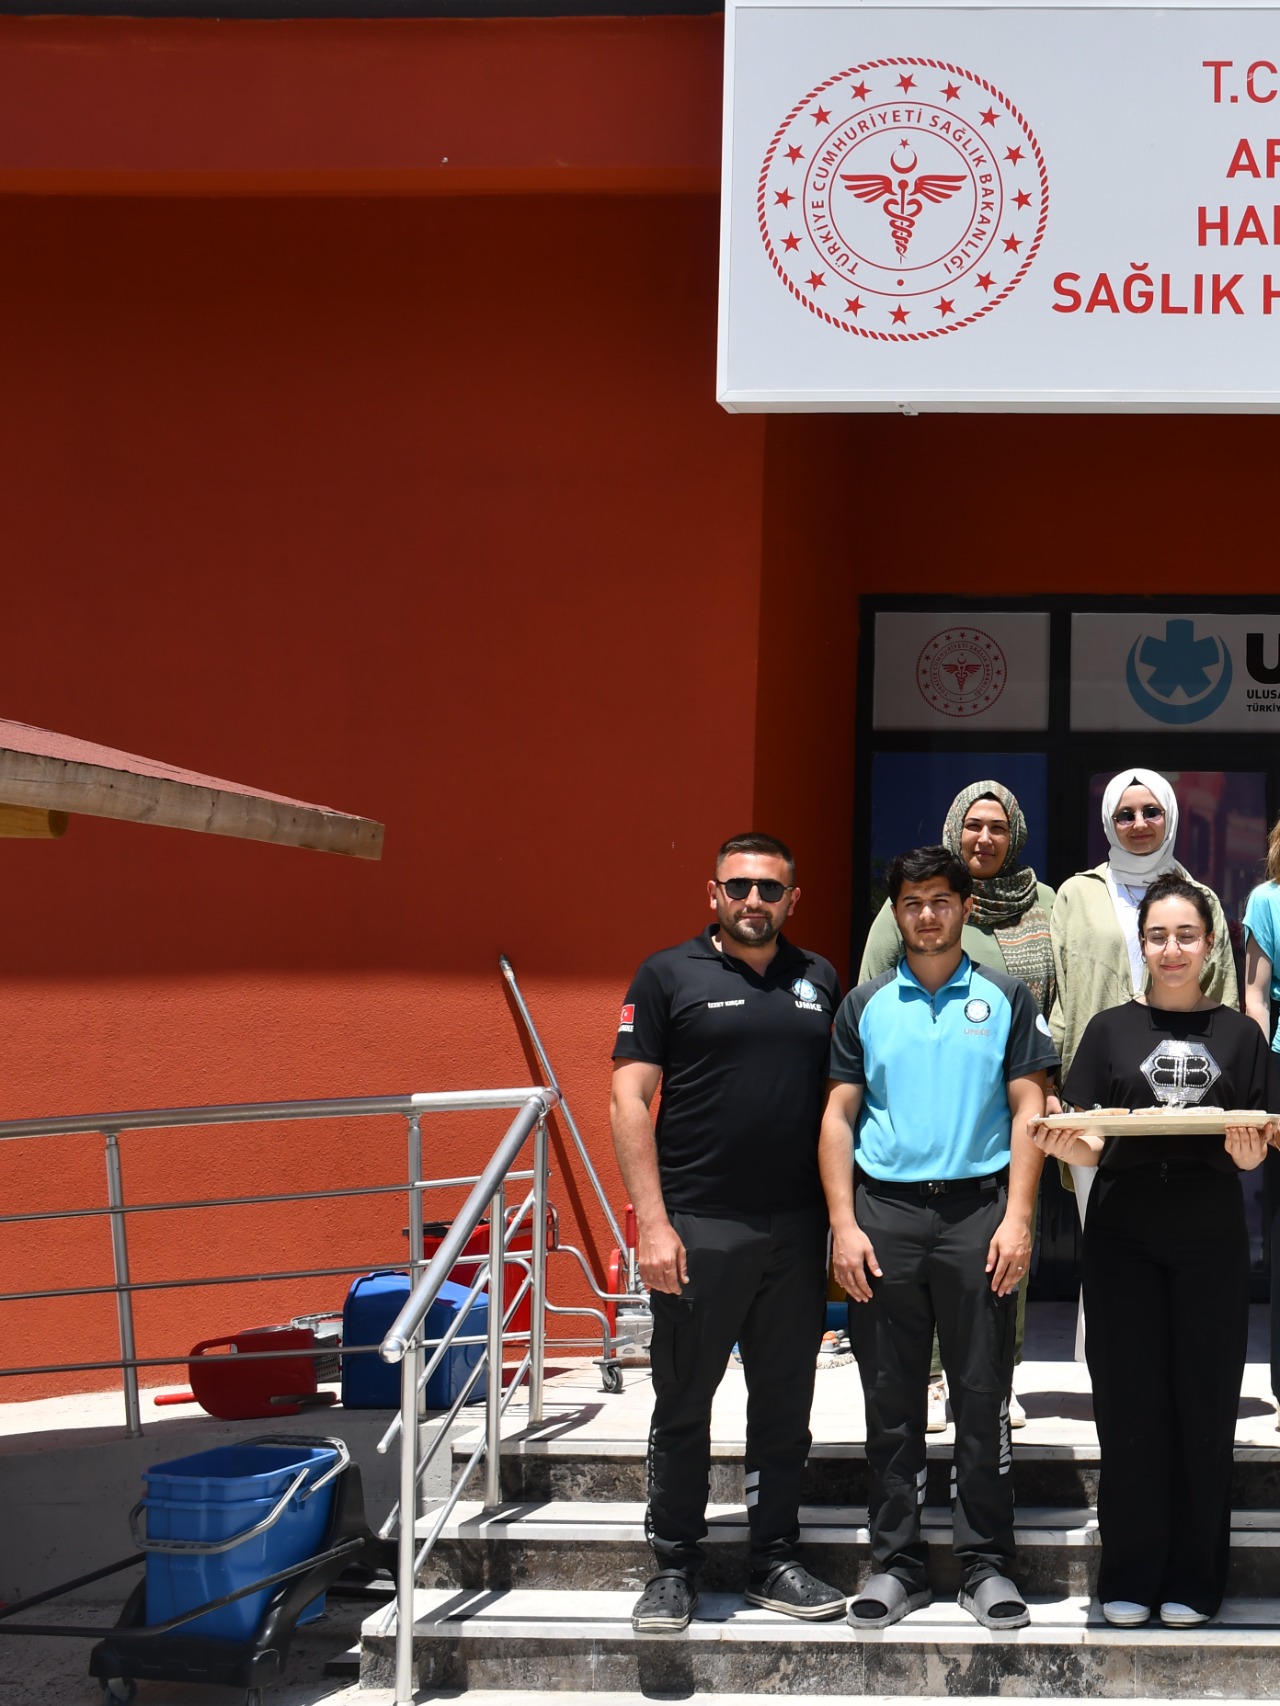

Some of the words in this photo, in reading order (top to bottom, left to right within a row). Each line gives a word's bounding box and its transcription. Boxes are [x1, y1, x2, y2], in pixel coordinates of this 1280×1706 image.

[812, 107, 923, 192] CUMHURİYETİ
[929, 114, 988, 168] SAĞLIK
[811, 199, 859, 275] TÜRKİYE
[943, 173, 995, 275] BAKANLIĞI
[1051, 262, 1245, 314] SAĞLIK
[794, 1000, 823, 1012] UMKE
[998, 1395, 1013, 1475] UMKE
